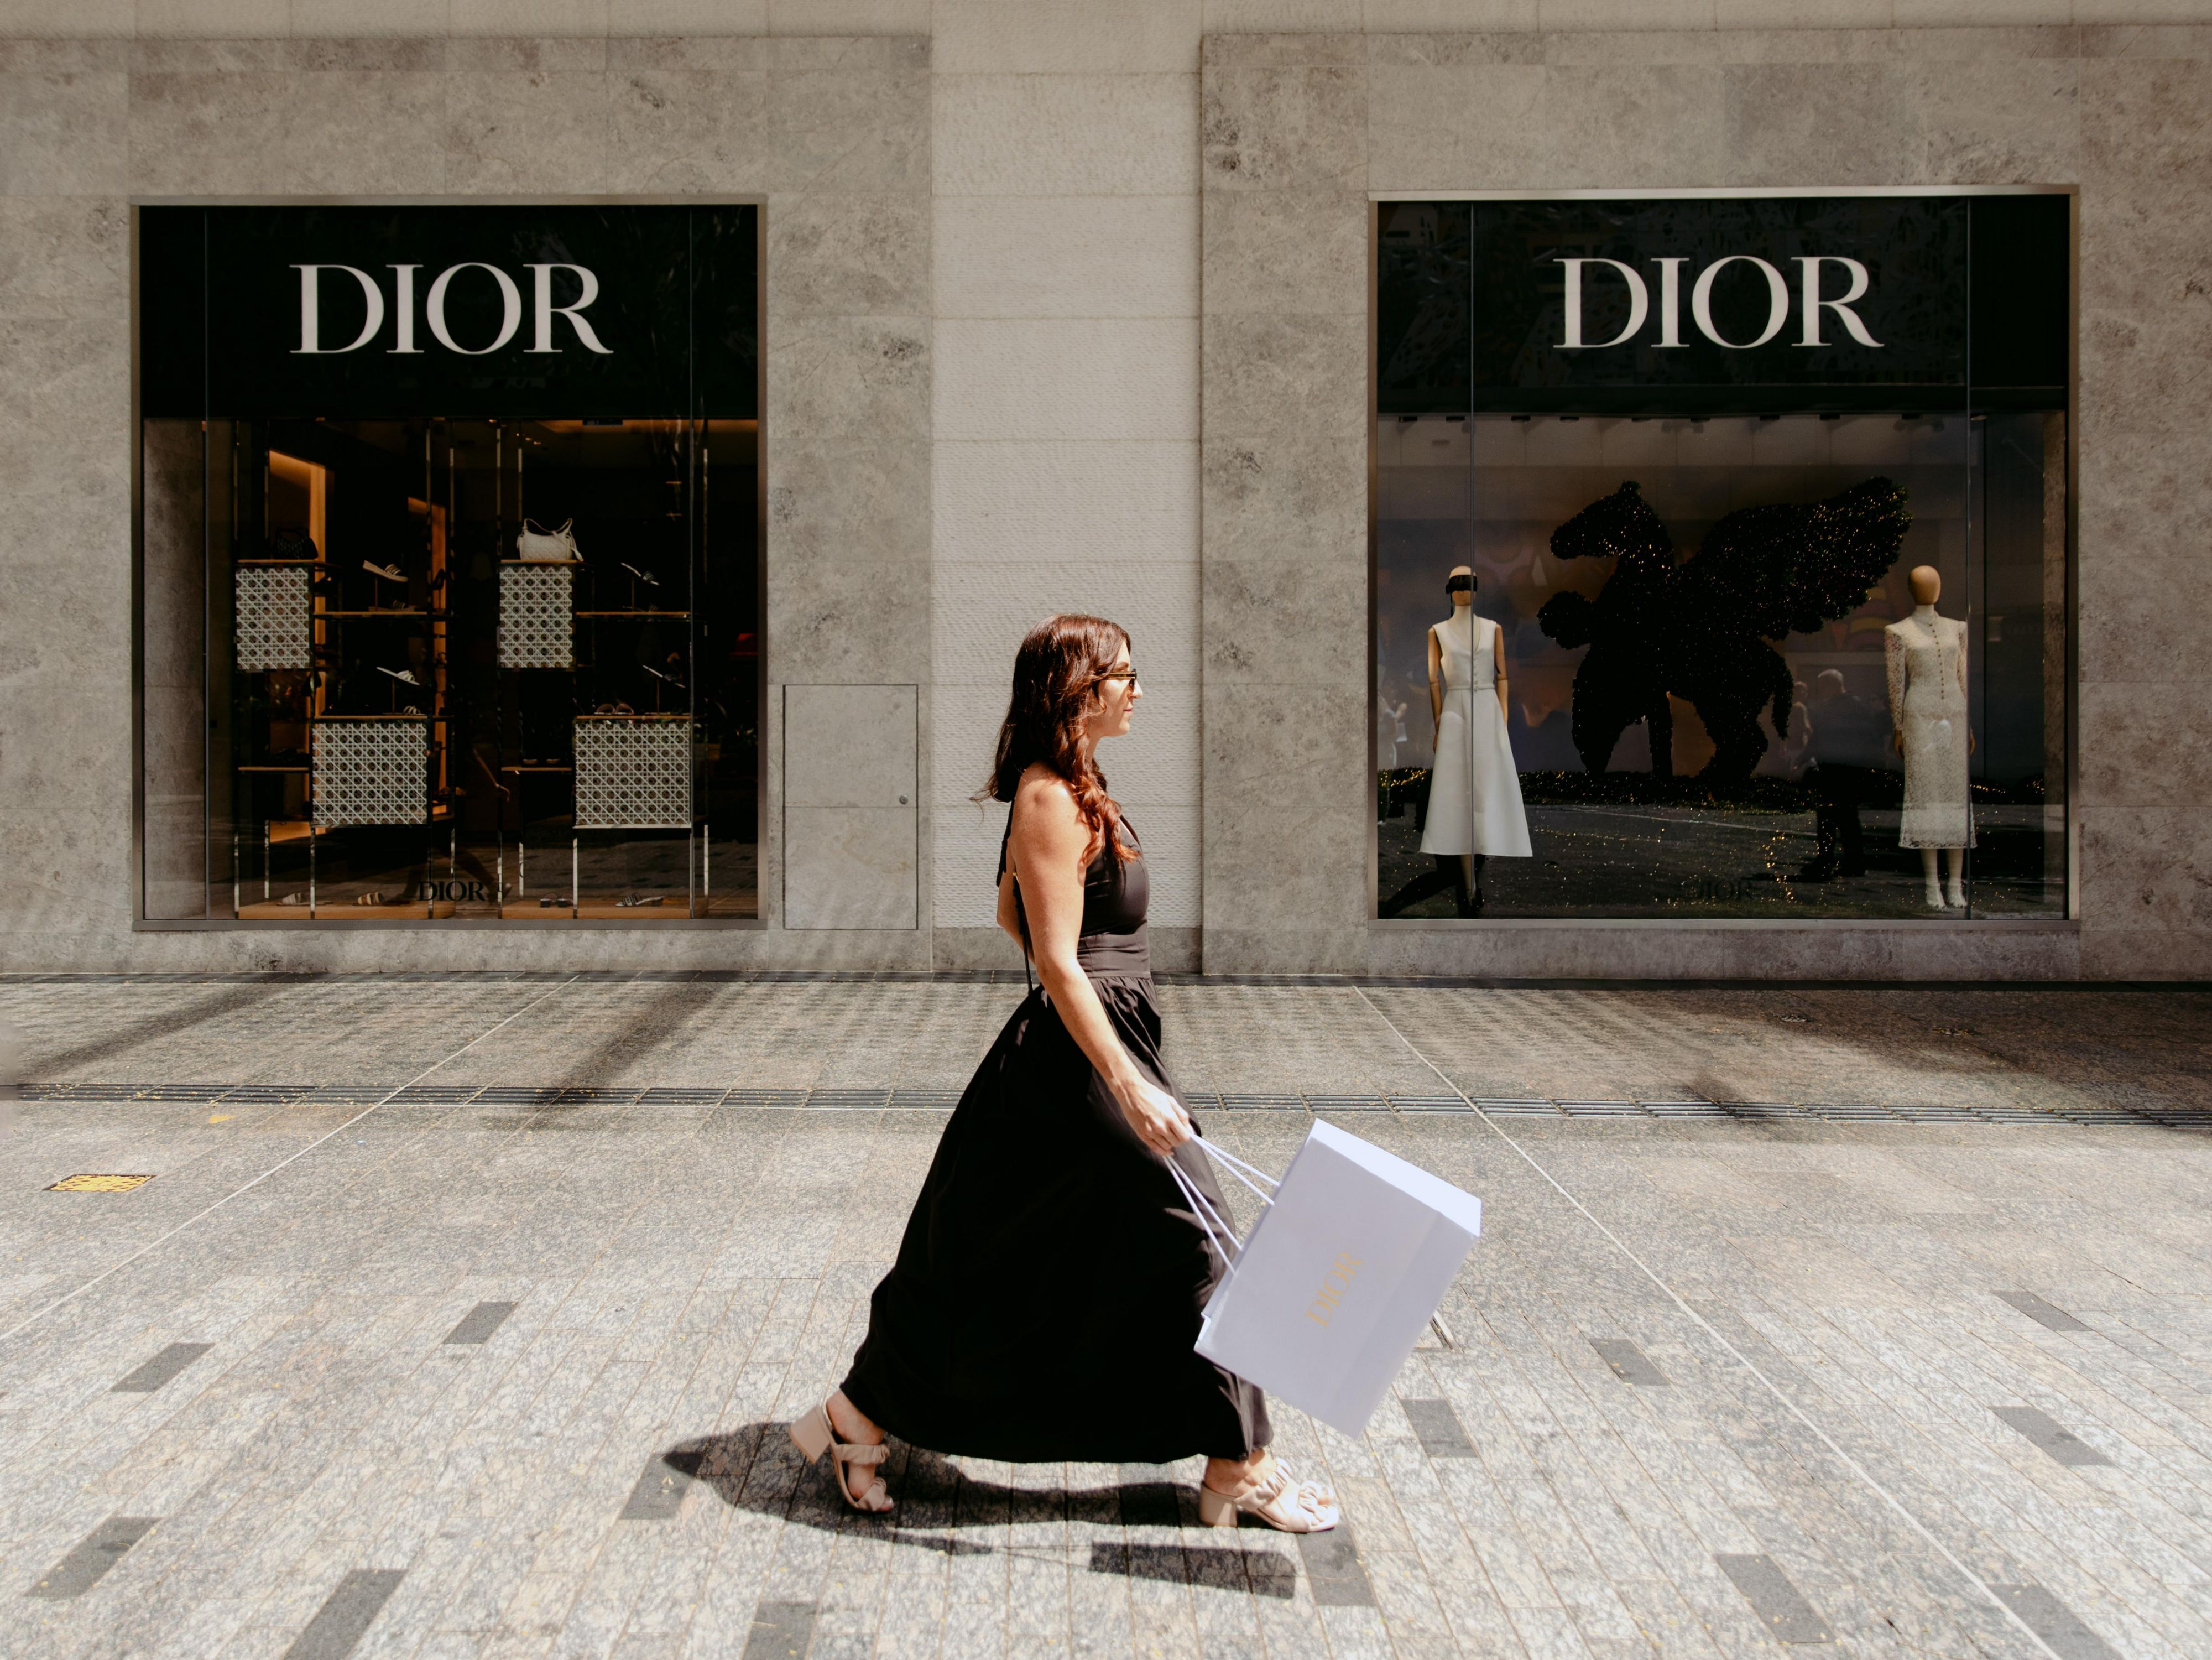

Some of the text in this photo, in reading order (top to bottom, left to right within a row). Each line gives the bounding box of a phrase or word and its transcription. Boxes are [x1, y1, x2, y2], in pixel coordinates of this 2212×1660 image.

[289, 263, 613, 354] DIOR
[1553, 256, 1885, 348] DIOR
[418, 881, 485, 901] DIOR
[1305, 1251, 1364, 1328] DIOR
